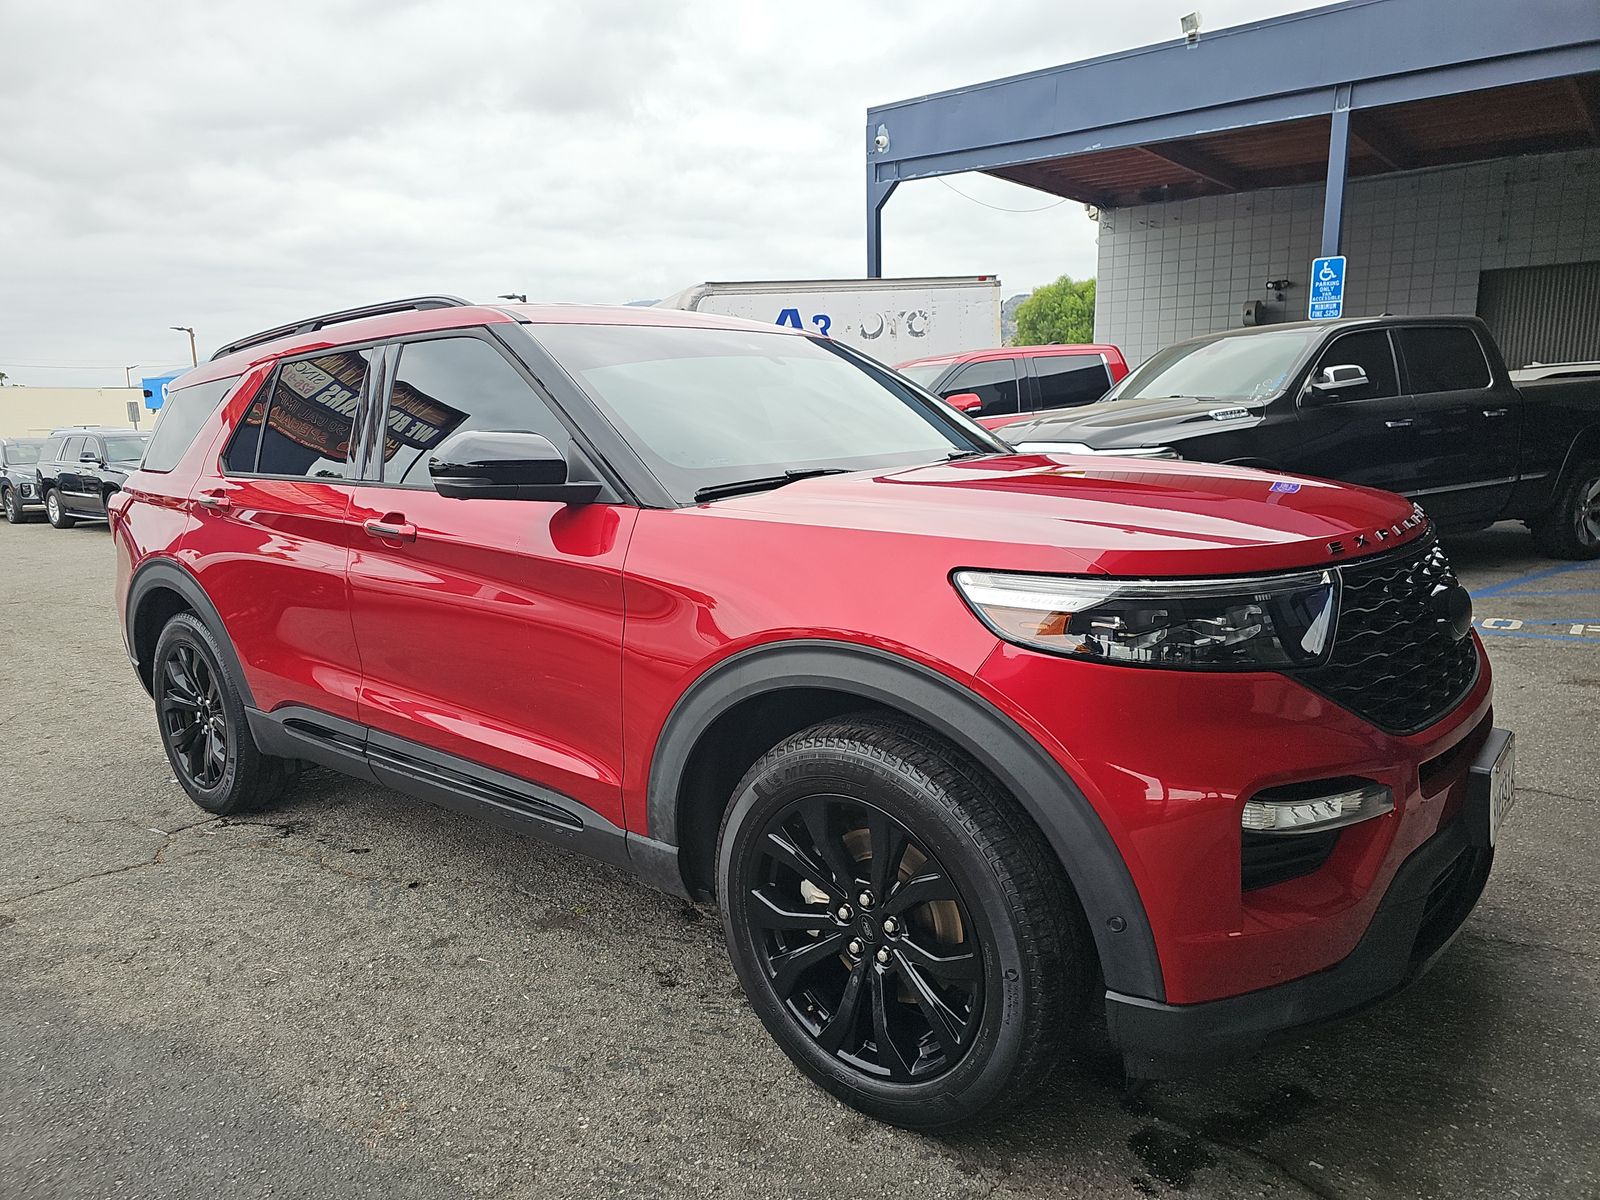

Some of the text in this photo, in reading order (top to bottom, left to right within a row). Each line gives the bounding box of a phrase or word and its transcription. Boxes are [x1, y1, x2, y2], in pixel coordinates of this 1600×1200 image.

[1315, 280, 1340, 288] PARKING
[1312, 310, 1323, 318] FINE
[1472, 616, 1524, 631] O
